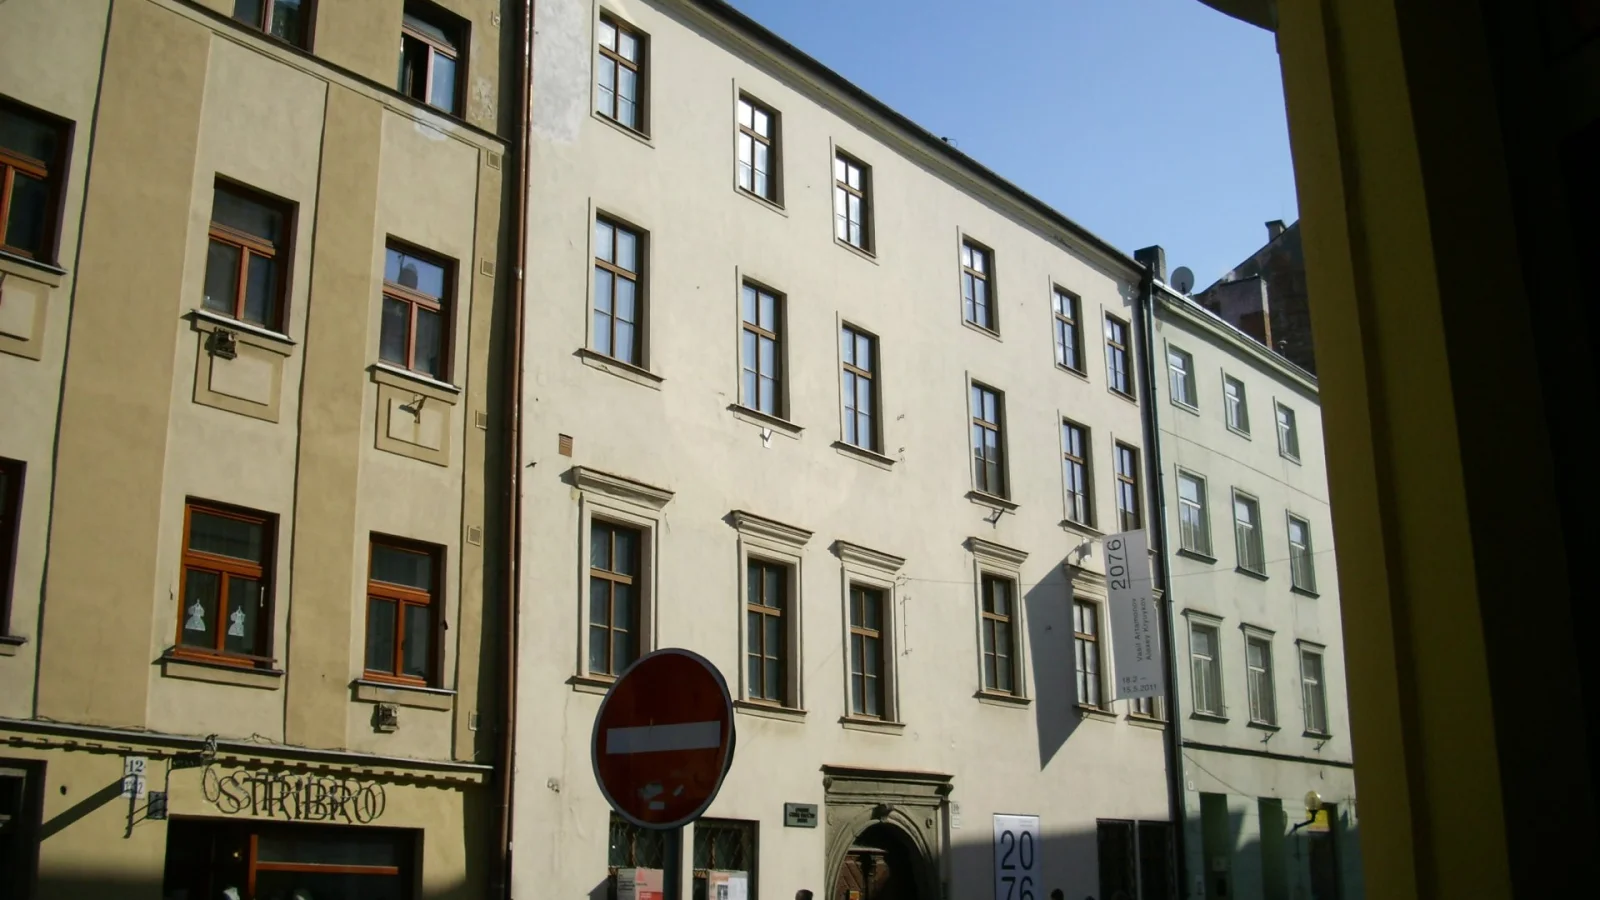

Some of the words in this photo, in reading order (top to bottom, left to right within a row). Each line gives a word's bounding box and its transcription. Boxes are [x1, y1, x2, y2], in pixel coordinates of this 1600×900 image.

[1106, 539, 1127, 590] 2076
[128, 759, 144, 773] 12
[1000, 829, 1034, 871] 20
[1001, 875, 1035, 900] 76
